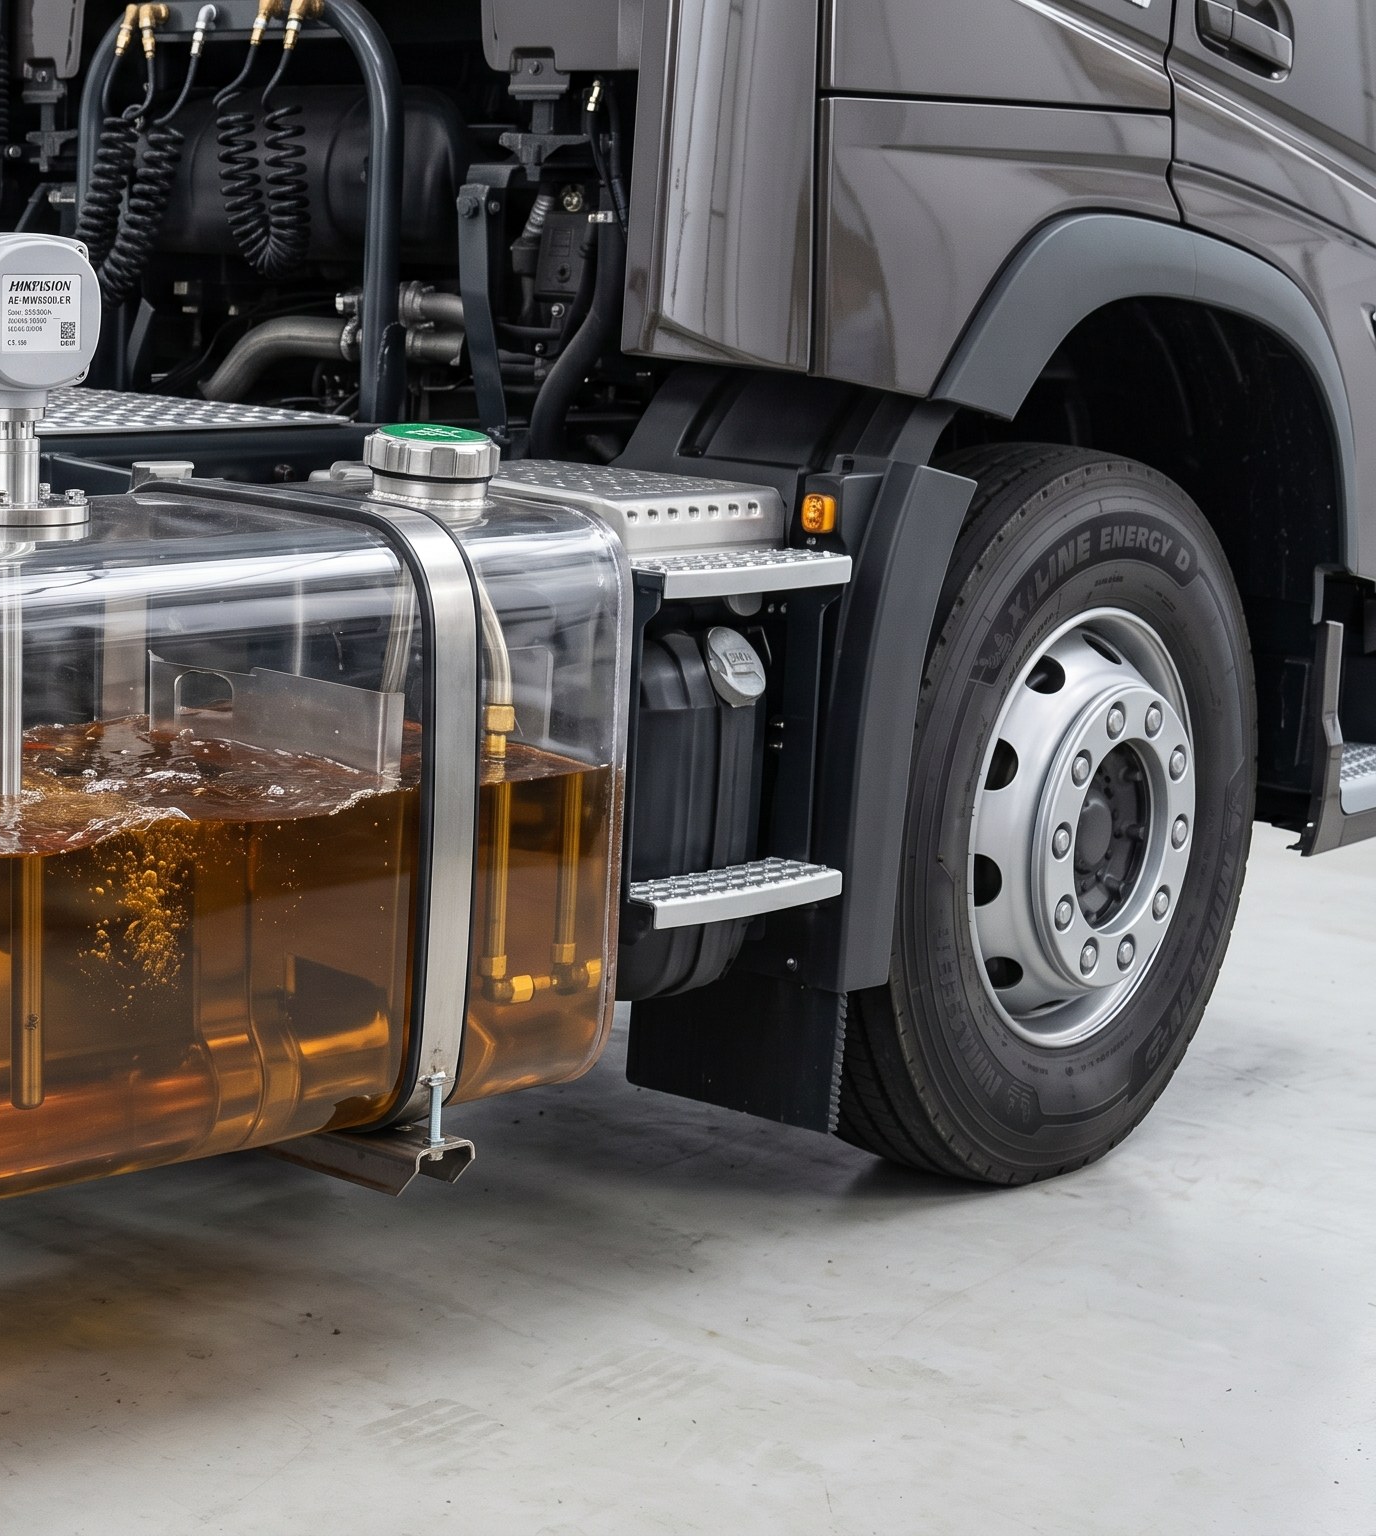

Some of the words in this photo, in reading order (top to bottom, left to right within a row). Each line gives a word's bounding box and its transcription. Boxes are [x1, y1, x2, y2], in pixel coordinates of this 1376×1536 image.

[1035, 530, 1092, 600] LINE
[1099, 524, 1173, 557] ENERGY
[1175, 547, 1191, 572] D
